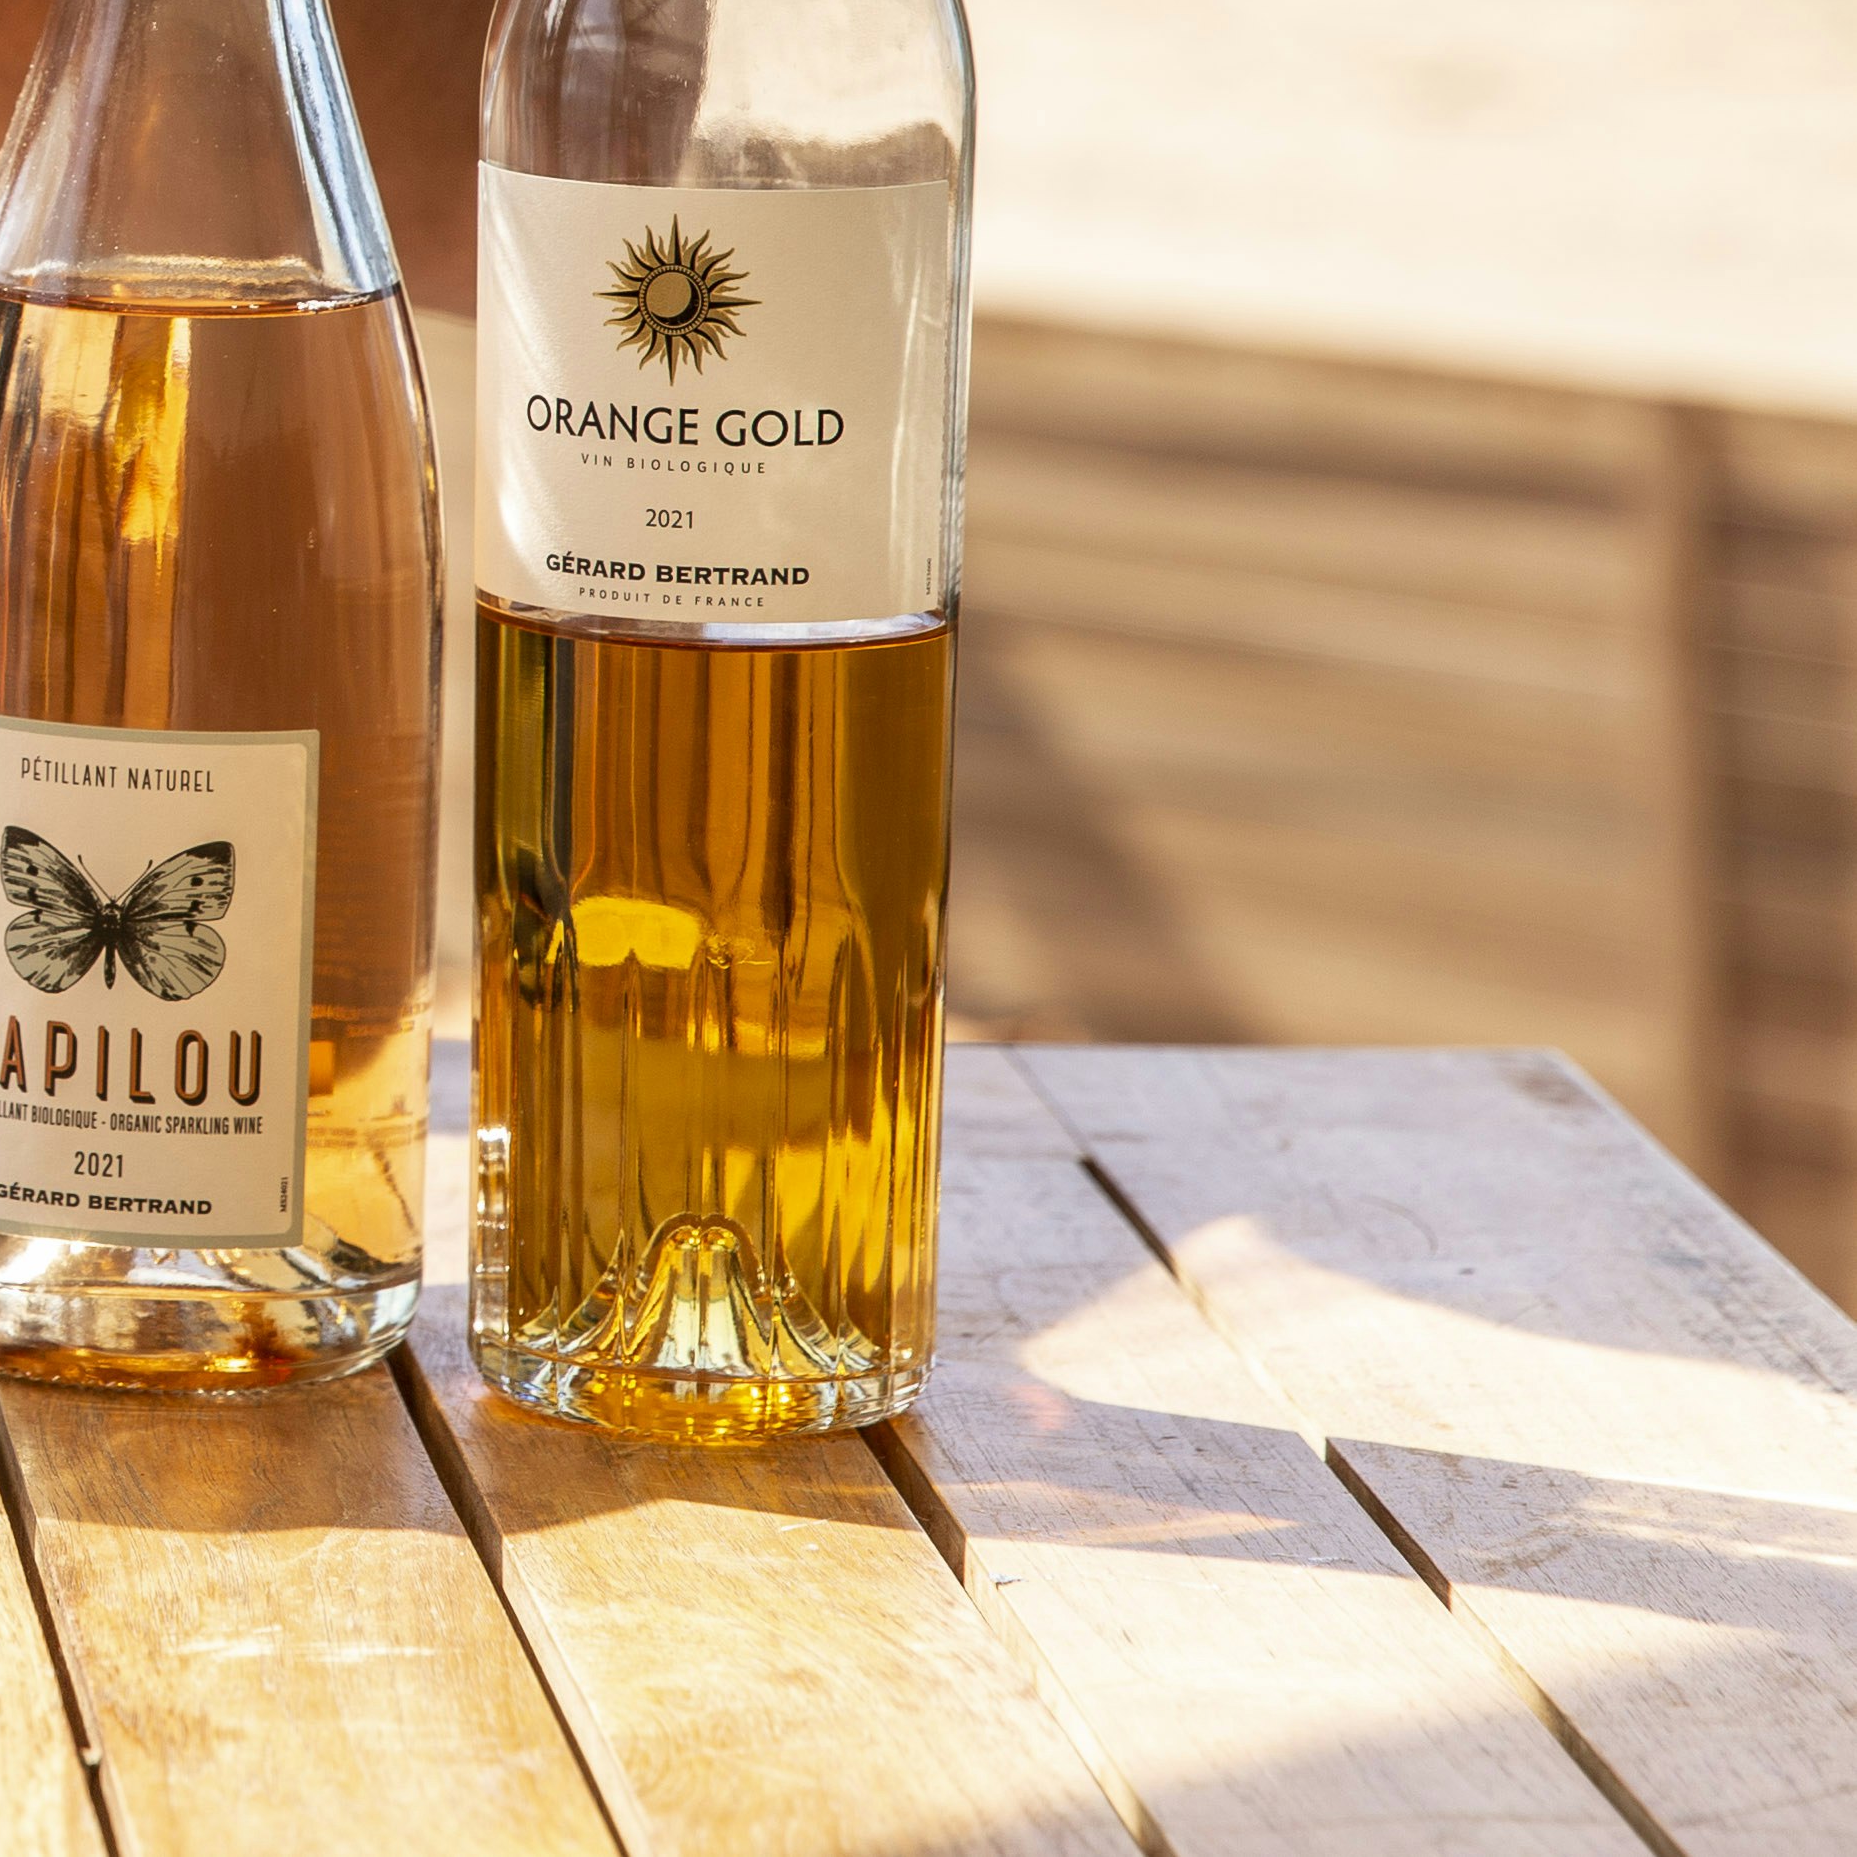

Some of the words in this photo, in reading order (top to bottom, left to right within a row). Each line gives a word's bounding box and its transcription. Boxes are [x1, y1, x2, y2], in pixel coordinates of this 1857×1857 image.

[527, 394, 699, 446] ORANGE
[716, 408, 844, 447] GOLD
[581, 453, 612, 467] VIN
[627, 457, 766, 476] BIOLOGIQUE
[645, 508, 694, 529] 2021
[546, 551, 646, 581] GÉRARD
[656, 564, 810, 586] BERTRAND
[579, 587, 651, 603] PRODUIT
[663, 595, 682, 605] DE
[695, 596, 765, 607] FRANCE
[21, 756, 117, 788] PÉTILLANT
[128, 768, 214, 792] NATUREL
[31, 1104, 97, 1130] BIOLOGIQUE
[110, 1113, 162, 1133] ORGANIC
[165, 1116, 229, 1135] SPARKLING
[234, 1116, 263, 1134] WINE
[74, 1151, 123, 1178] 2021
[88, 1195, 212, 1215] BERTRAND
